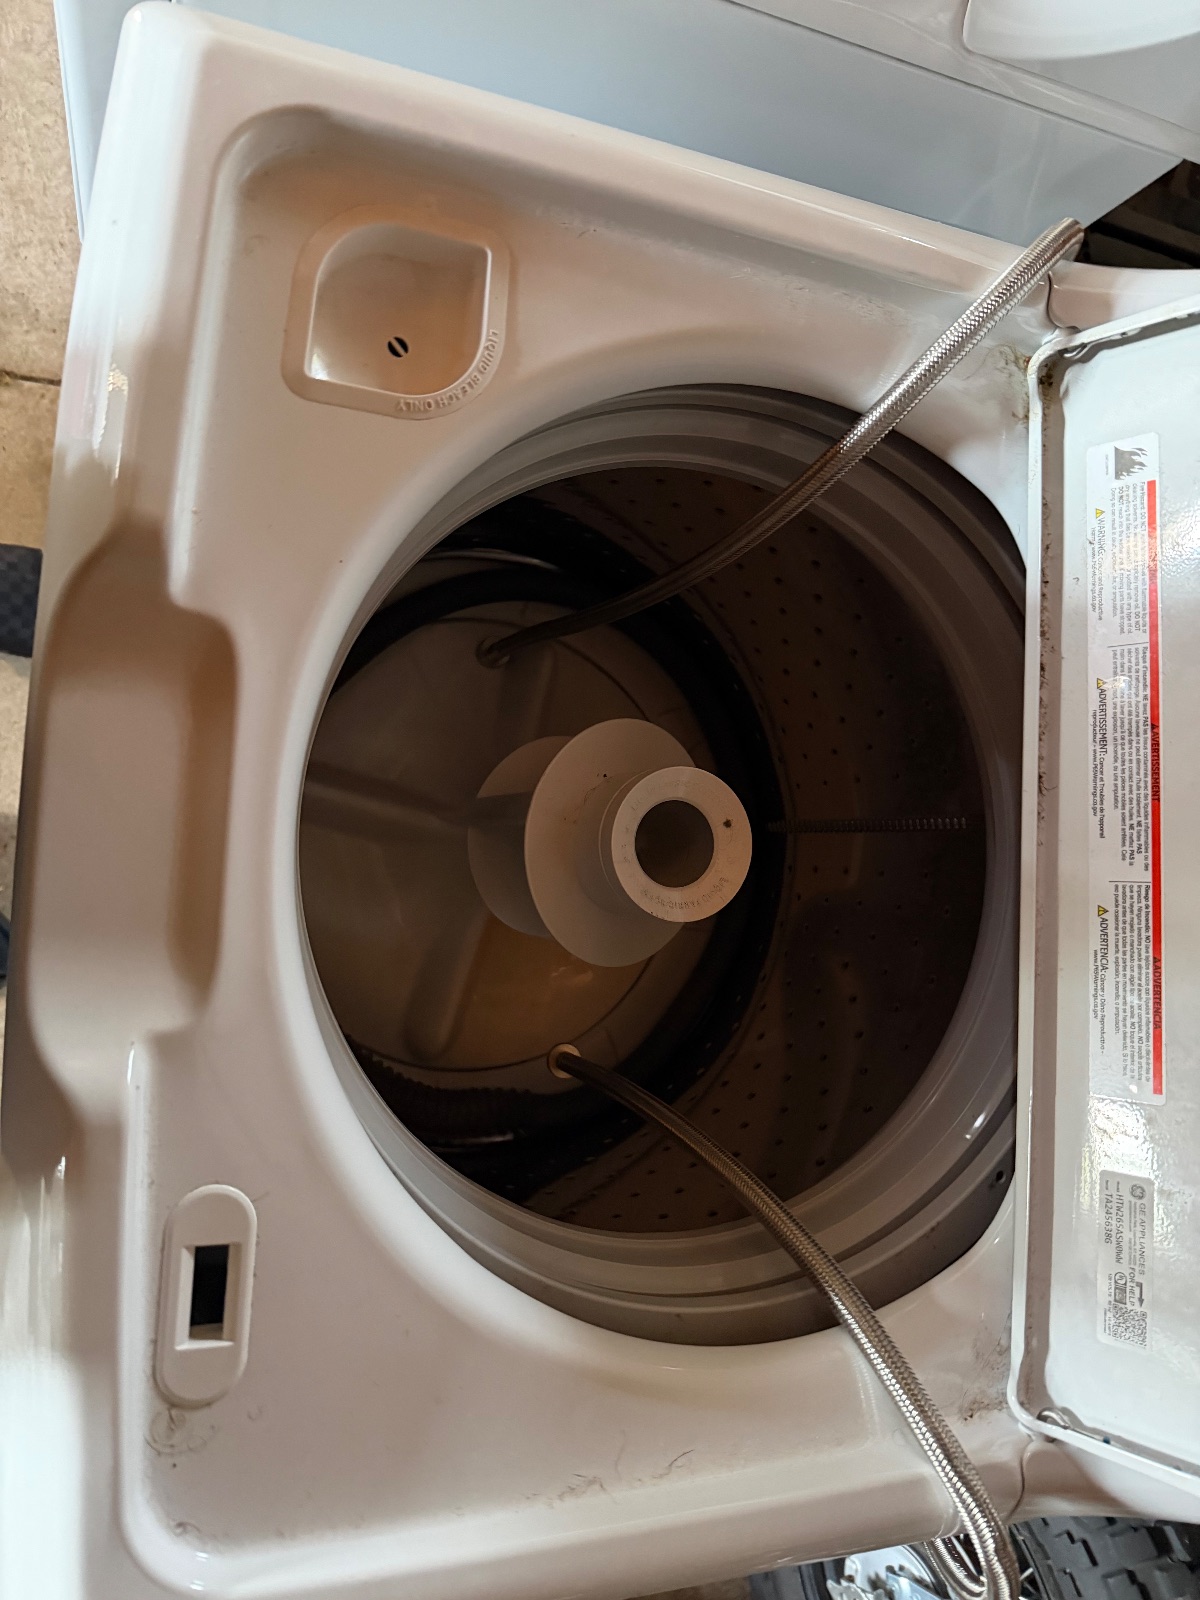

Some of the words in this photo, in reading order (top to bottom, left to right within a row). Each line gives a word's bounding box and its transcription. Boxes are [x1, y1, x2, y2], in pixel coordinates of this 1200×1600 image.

[480, 329, 500, 374] LIQUID
[397, 399, 435, 412] ONLY
[436, 374, 481, 409] BLEACH
[1097, 518, 1106, 557] WARNING:
[1099, 689, 1107, 756] ADVERTISSEMENT:
[1151, 731, 1160, 802] AVERTISSEMENT
[1129, 823, 1134, 831] NE
[1100, 917, 1109, 973] ADVERTENCIA:
[1145, 935, 1151, 943] NO
[1153, 964, 1162, 1029] ADVERTENCIA
[1130, 1021, 1135, 1029] NO
[1138, 1036, 1143, 1044] NO
[1105, 1193, 1113, 1244] TA245638G
[1139, 1203, 1146, 1216] GE
